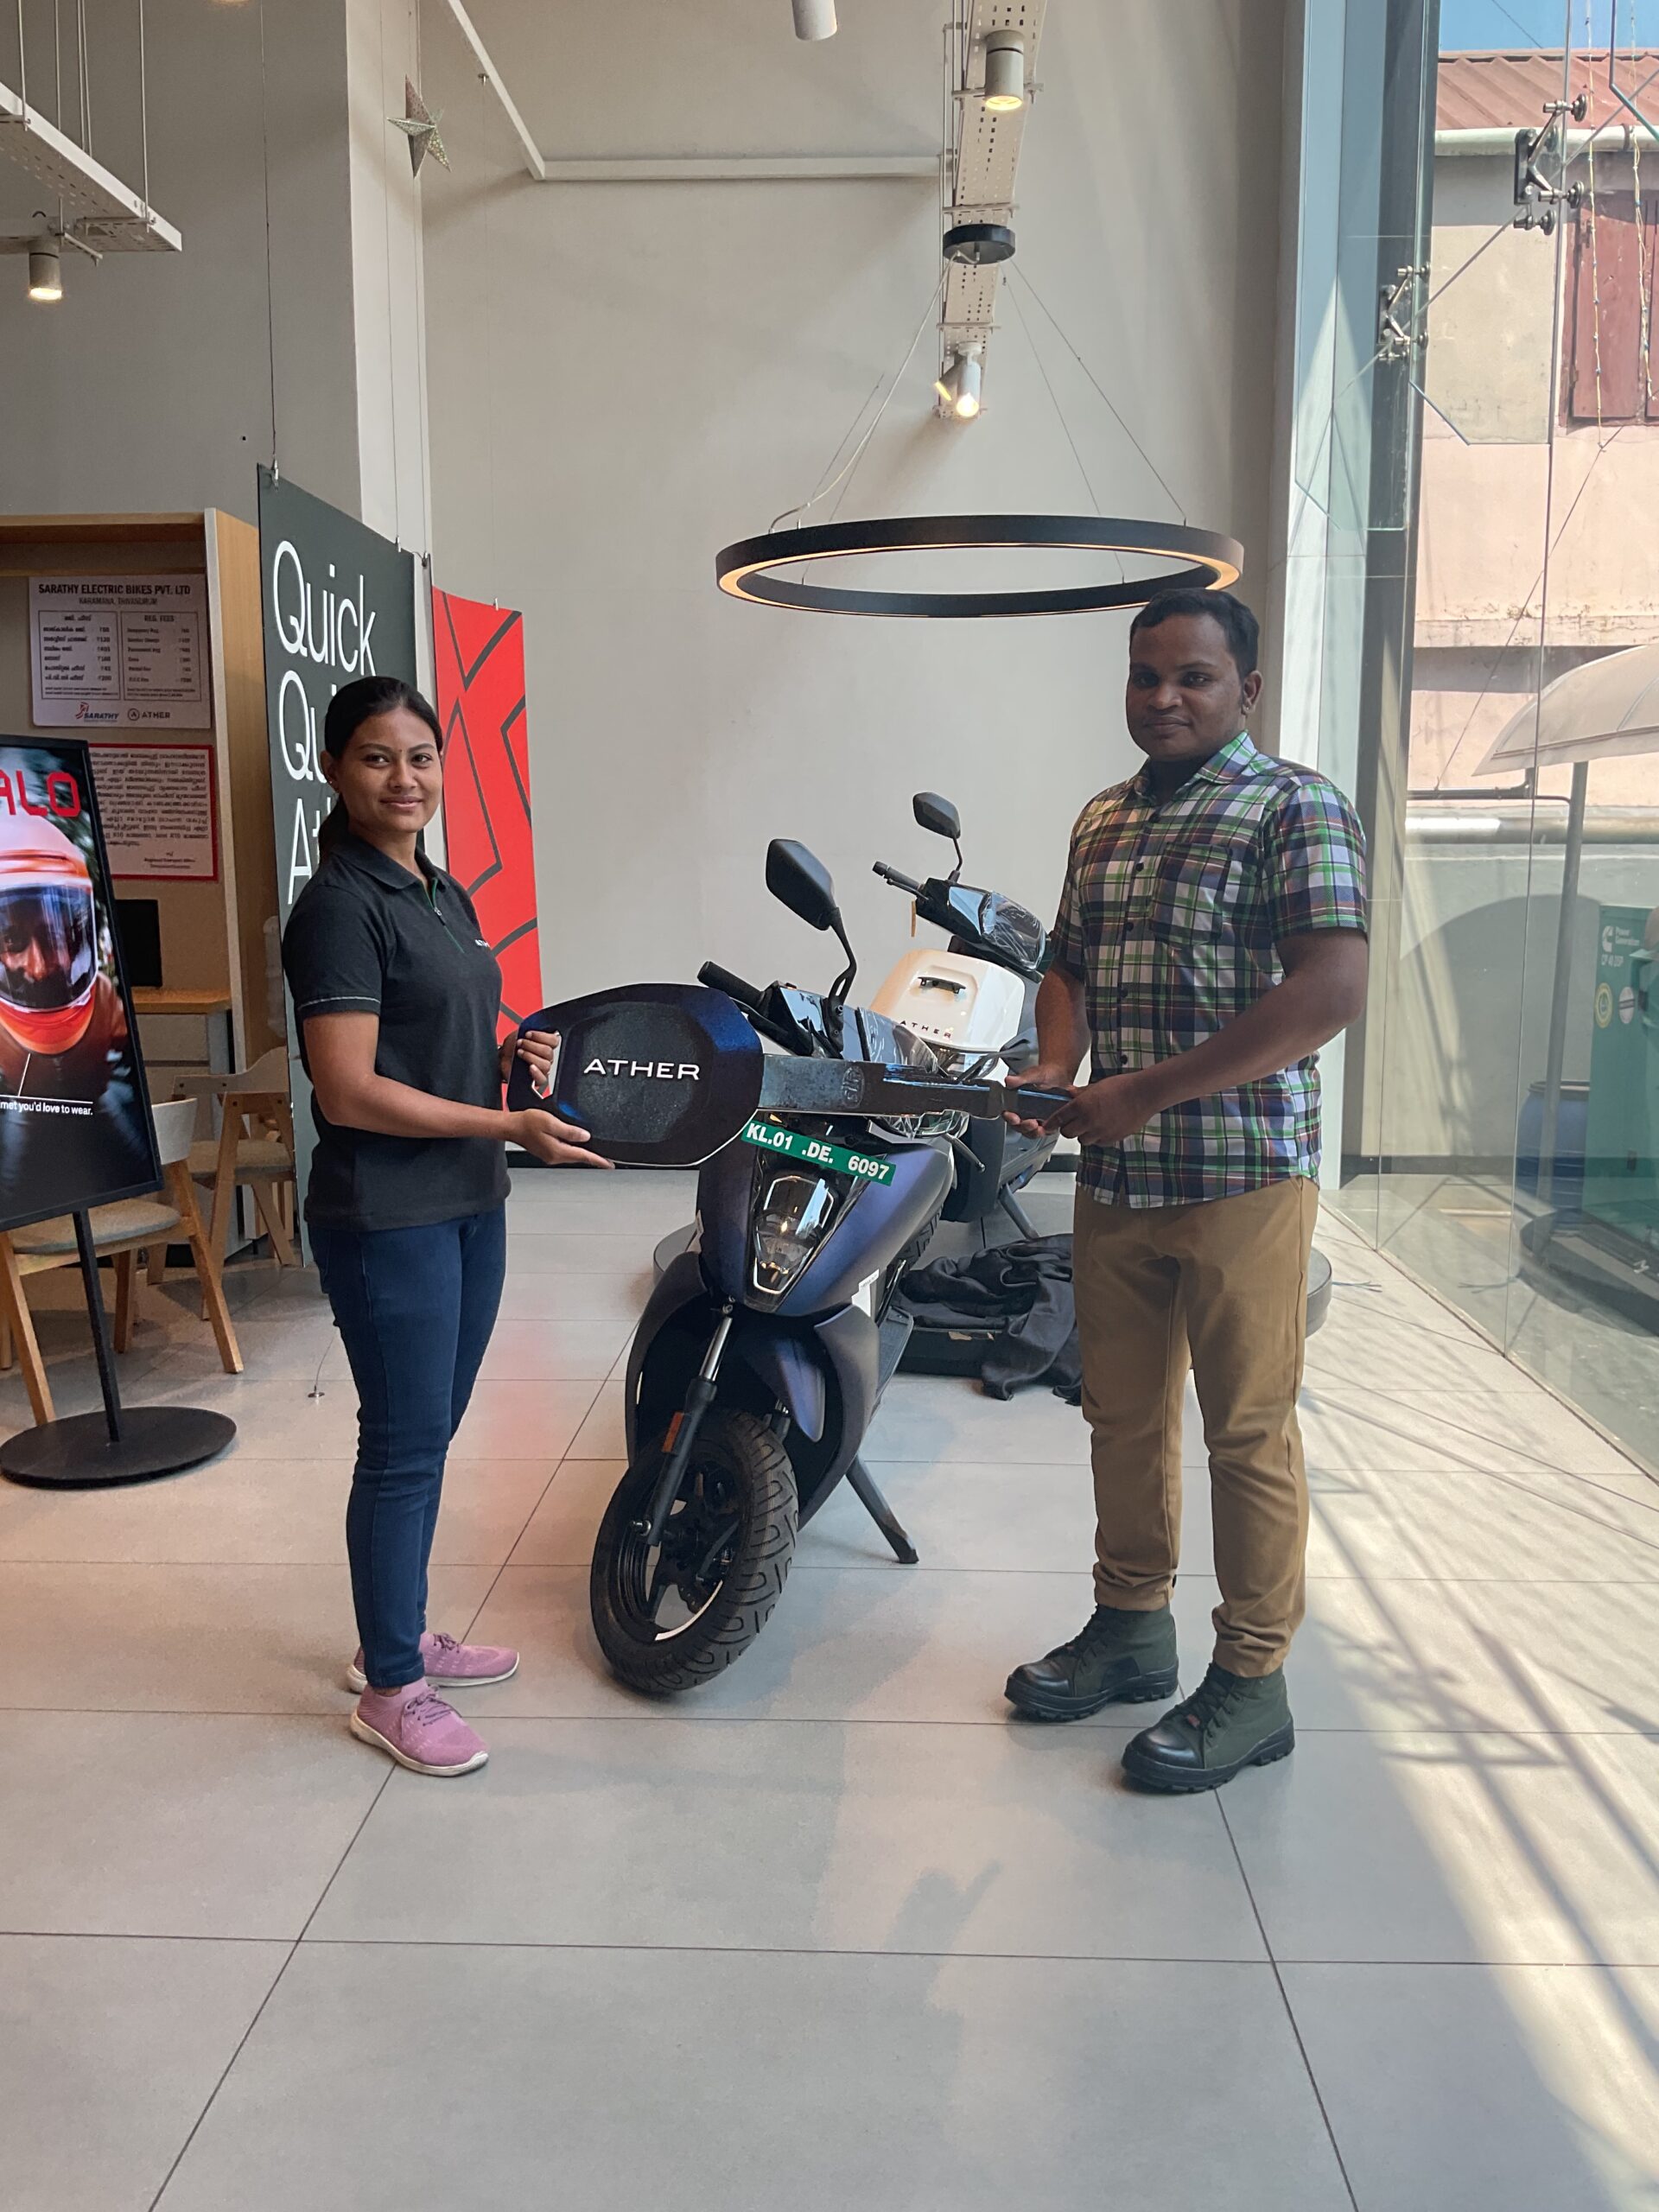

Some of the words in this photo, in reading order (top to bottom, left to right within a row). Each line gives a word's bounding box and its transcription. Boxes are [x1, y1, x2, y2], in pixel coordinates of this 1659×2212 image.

[39, 584, 79, 594] SARATHY
[81, 584, 124, 594] ELECTRIC
[126, 585, 152, 594] BIKES
[155, 585, 173, 594] PVT.
[175, 585, 190, 594] LTD
[273, 540, 377, 677] Quick
[899, 1020, 952, 1039] ATHER
[583, 1058, 701, 1081] ATHER
[18, 1102, 41, 1113] you'd
[42, 1103, 60, 1114] love
[61, 1105, 70, 1114] to
[71, 1107, 93, 1116] wear.
[746, 1123, 794, 1152] KL.01
[848, 1155, 890, 1181] 6097
